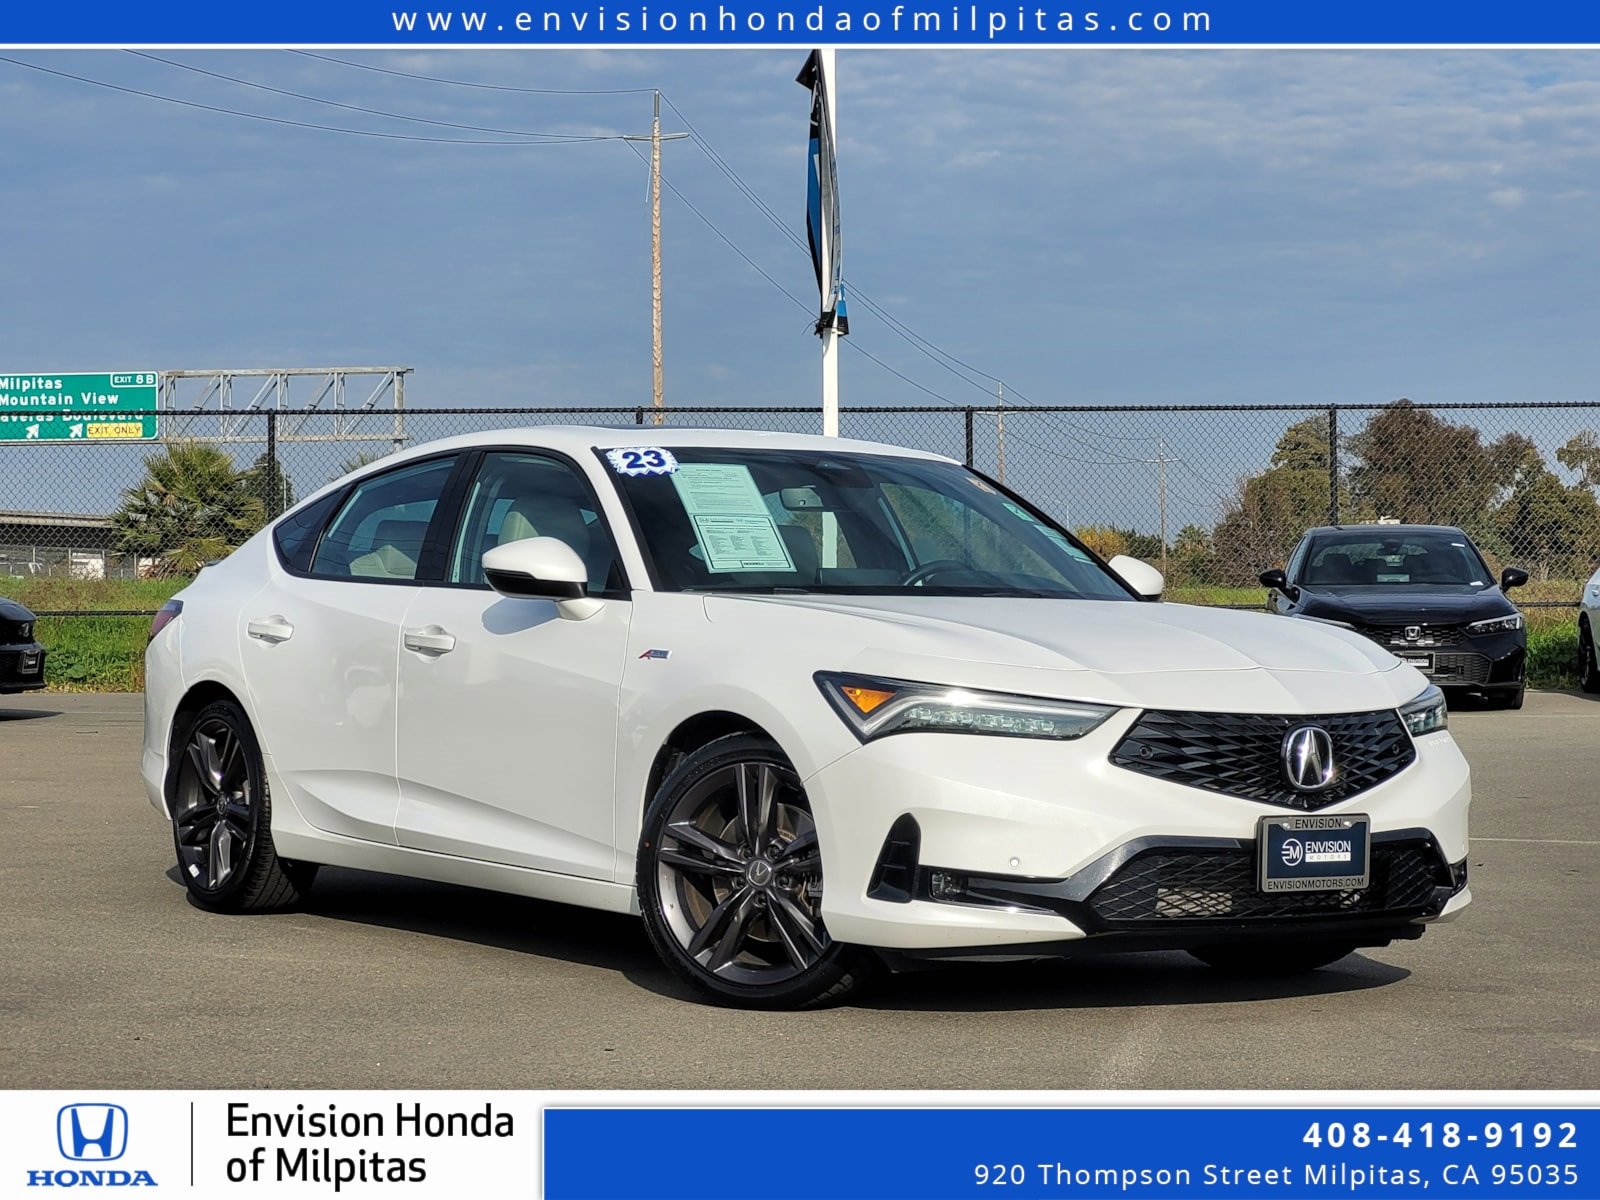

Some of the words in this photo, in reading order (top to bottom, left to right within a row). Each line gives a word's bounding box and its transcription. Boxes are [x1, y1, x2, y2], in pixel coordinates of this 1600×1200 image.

[0, 377, 63, 392] Milpitas
[114, 376, 132, 384] EXIT
[0, 393, 74, 406] Mountain
[81, 392, 119, 405] View
[88, 426, 110, 435] EXIT
[114, 426, 141, 434] ONLY
[622, 450, 667, 469] 23
[1295, 818, 1342, 829] ENVISION
[1305, 840, 1351, 853] ENVISION
[1267, 877, 1364, 890] ENVISIONMOTORS.COM
